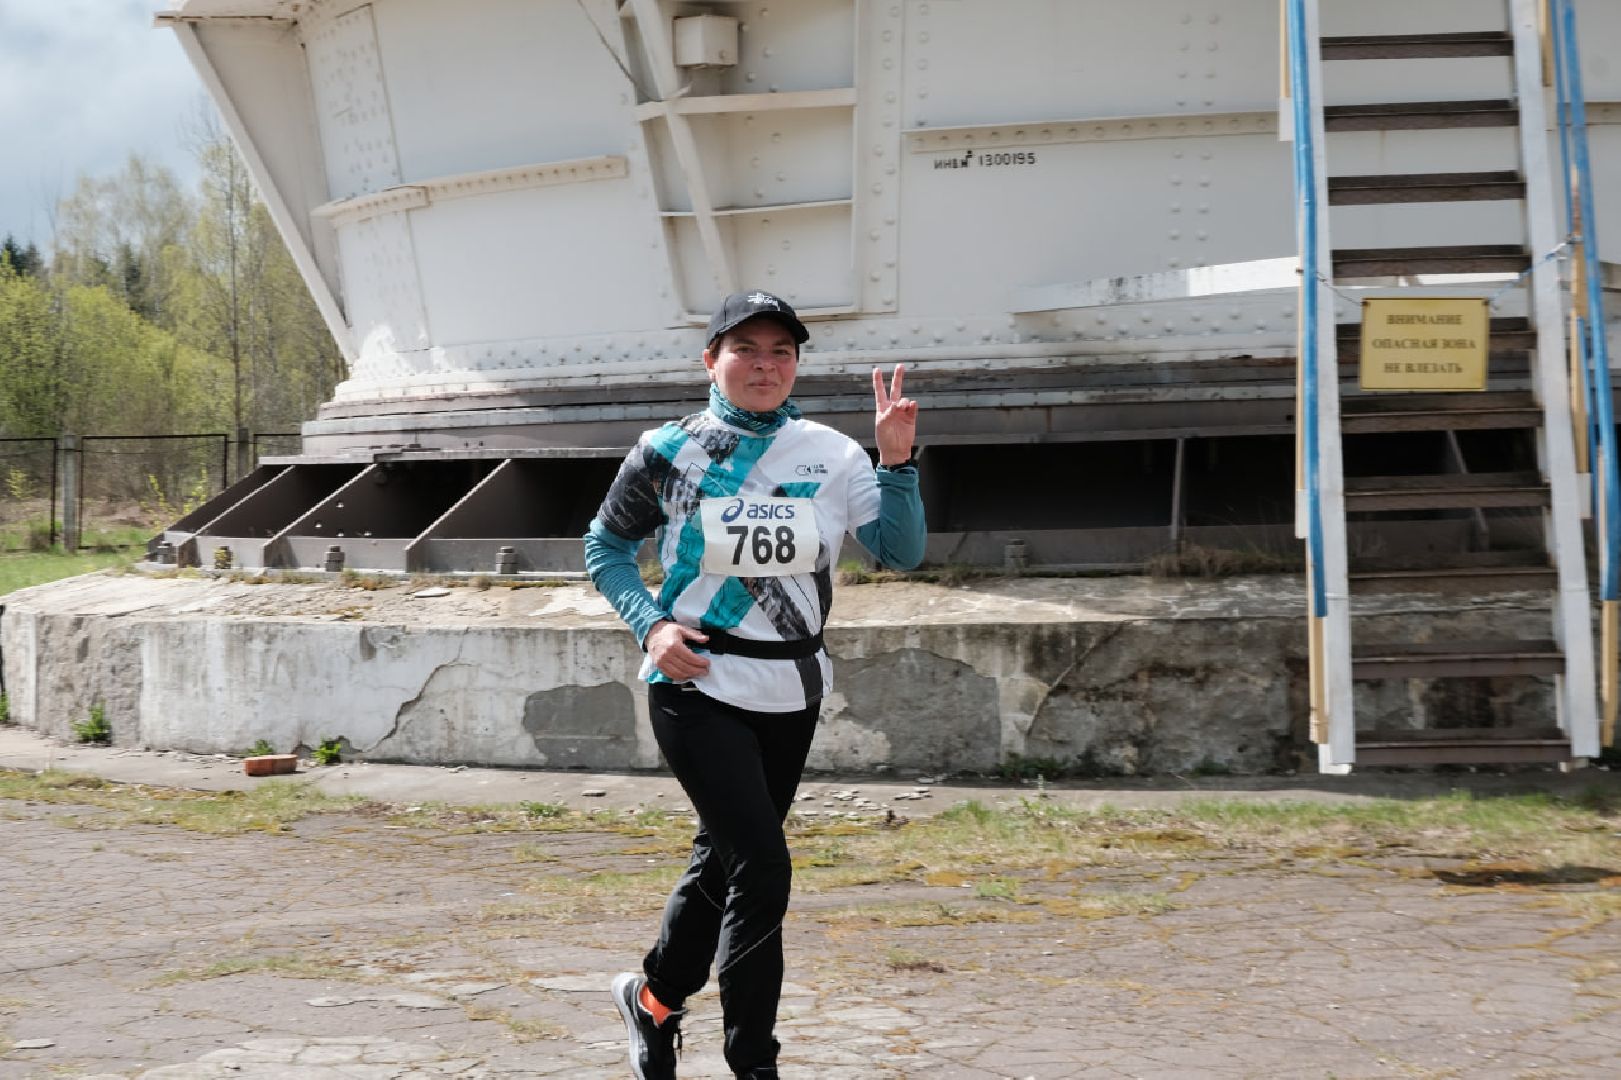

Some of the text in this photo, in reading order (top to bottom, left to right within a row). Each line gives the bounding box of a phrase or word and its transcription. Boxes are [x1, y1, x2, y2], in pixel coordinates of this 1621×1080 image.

[978, 152, 1036, 166] 1300195
[1385, 314, 1463, 325] ВНИМАНИЕ
[1371, 338, 1477, 349] ОПАСНАЯ ЗОНА
[1383, 362, 1463, 373] НЕ ВЛЕЗАТЬ
[746, 503, 795, 520] asics
[726, 525, 796, 566] 768
